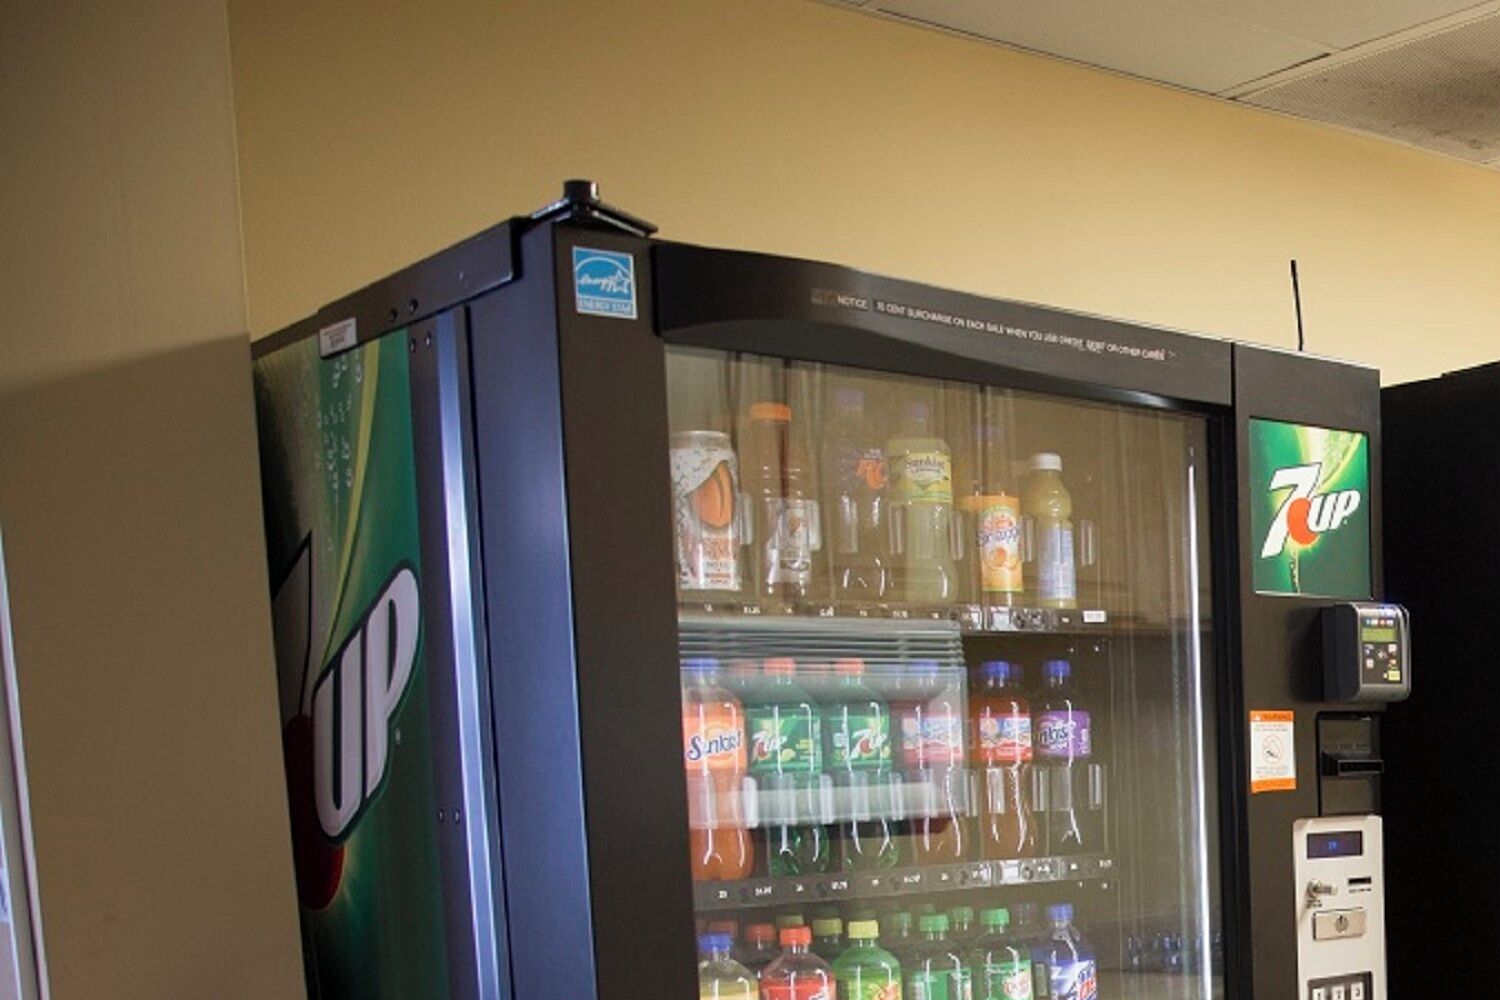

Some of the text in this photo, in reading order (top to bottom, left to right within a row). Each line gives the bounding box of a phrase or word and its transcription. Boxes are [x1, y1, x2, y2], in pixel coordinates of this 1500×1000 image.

[837, 295, 868, 309] NOTICE
[907, 307, 952, 324] SURCHARGE
[953, 316, 965, 327] ON
